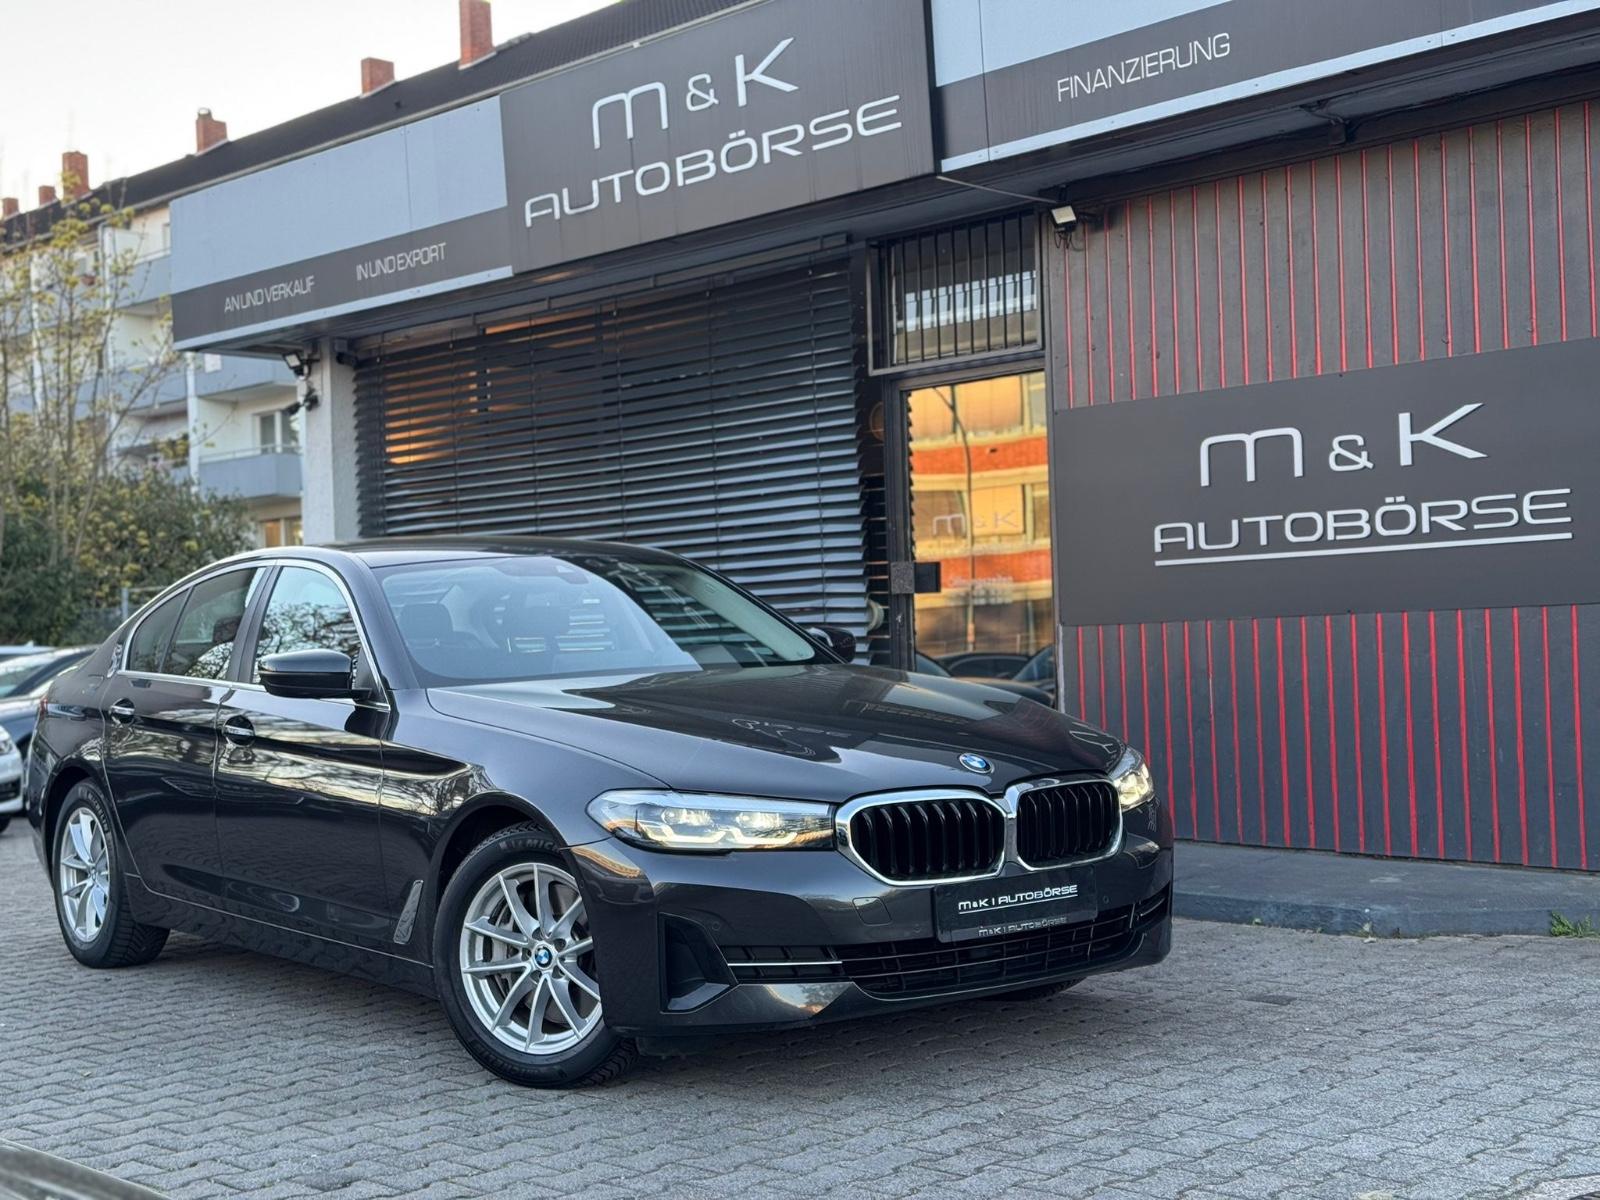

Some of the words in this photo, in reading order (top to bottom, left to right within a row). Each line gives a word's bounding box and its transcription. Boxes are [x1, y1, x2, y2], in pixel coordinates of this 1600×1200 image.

[685, 73, 719, 112] &
[734, 36, 799, 107] K
[1057, 32, 1231, 102] FINANZIERUNG
[524, 94, 903, 228] AUTOBÖRSE
[224, 294, 240, 313] AN
[240, 287, 264, 309] UND
[264, 275, 315, 303] VERKAUF
[356, 262, 369, 281] IN
[369, 255, 396, 278] UND
[396, 242, 447, 271] EXPORT
[1328, 434, 1374, 472] &
[1398, 402, 1489, 467] K
[1153, 488, 1573, 553] AUTOBÖRSE
[998, 884, 1078, 905] AUTOBÖRSE
